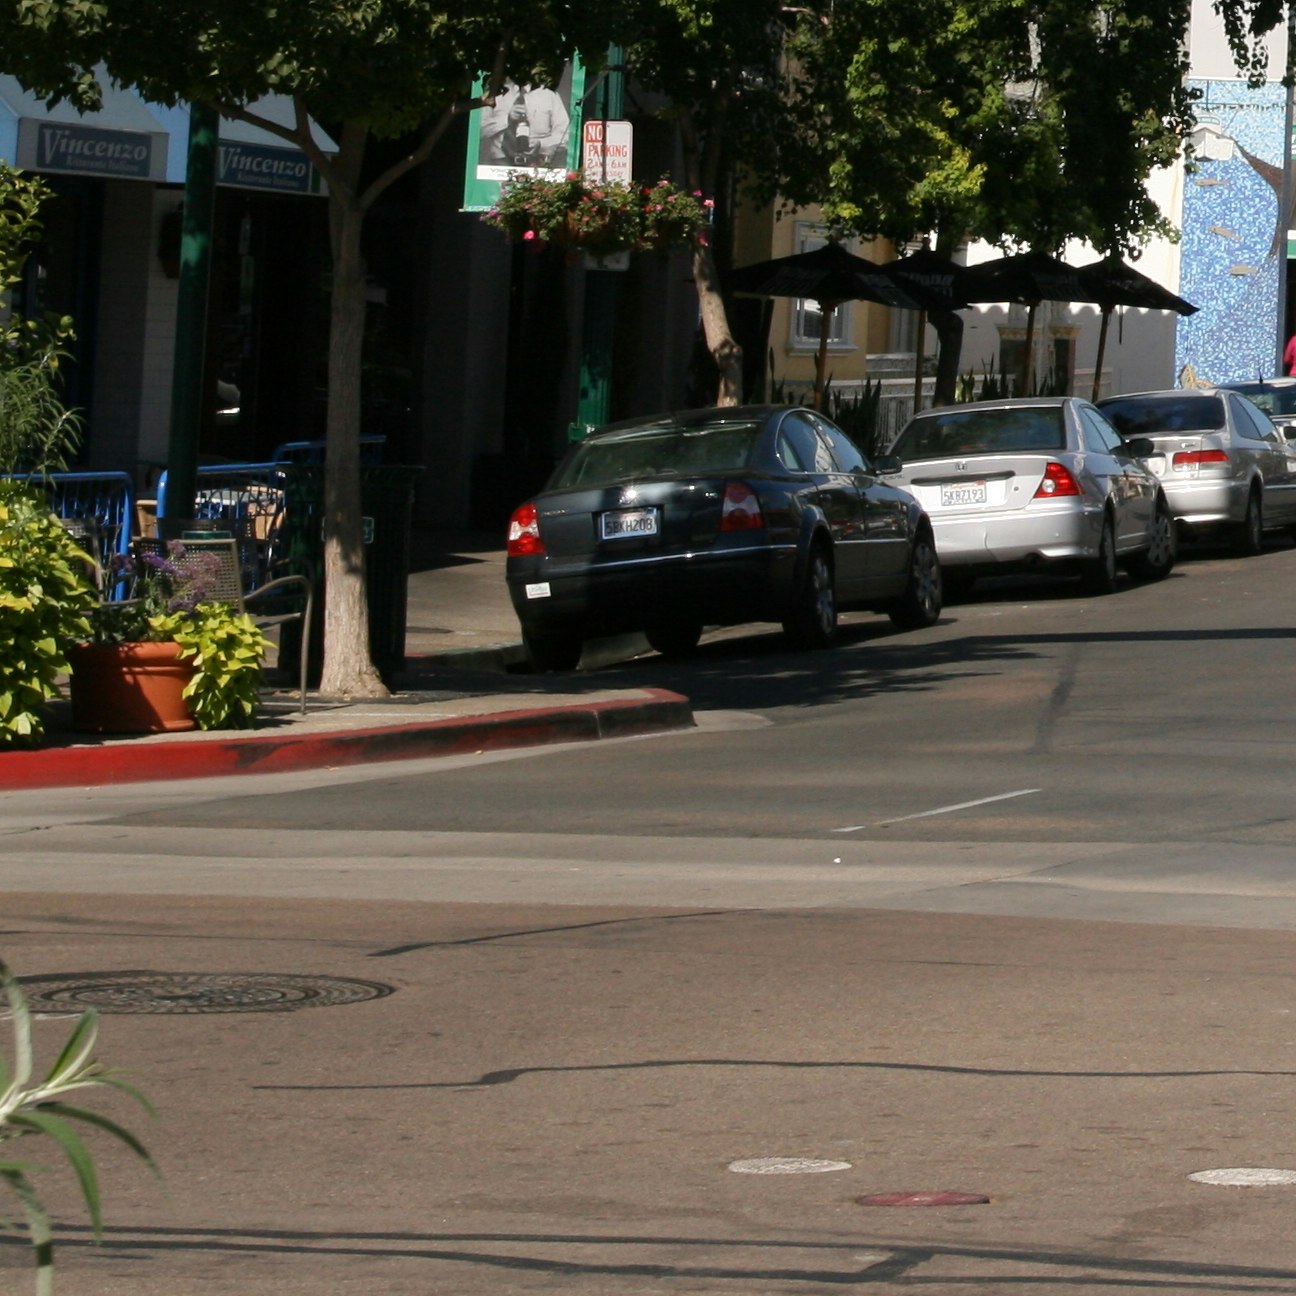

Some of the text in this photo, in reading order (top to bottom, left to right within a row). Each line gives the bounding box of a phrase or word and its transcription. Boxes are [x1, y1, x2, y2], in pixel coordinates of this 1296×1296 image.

[42, 127, 149, 165] Vincenzo
[587, 124, 604, 142] NO
[217, 145, 307, 179] Vincenzo
